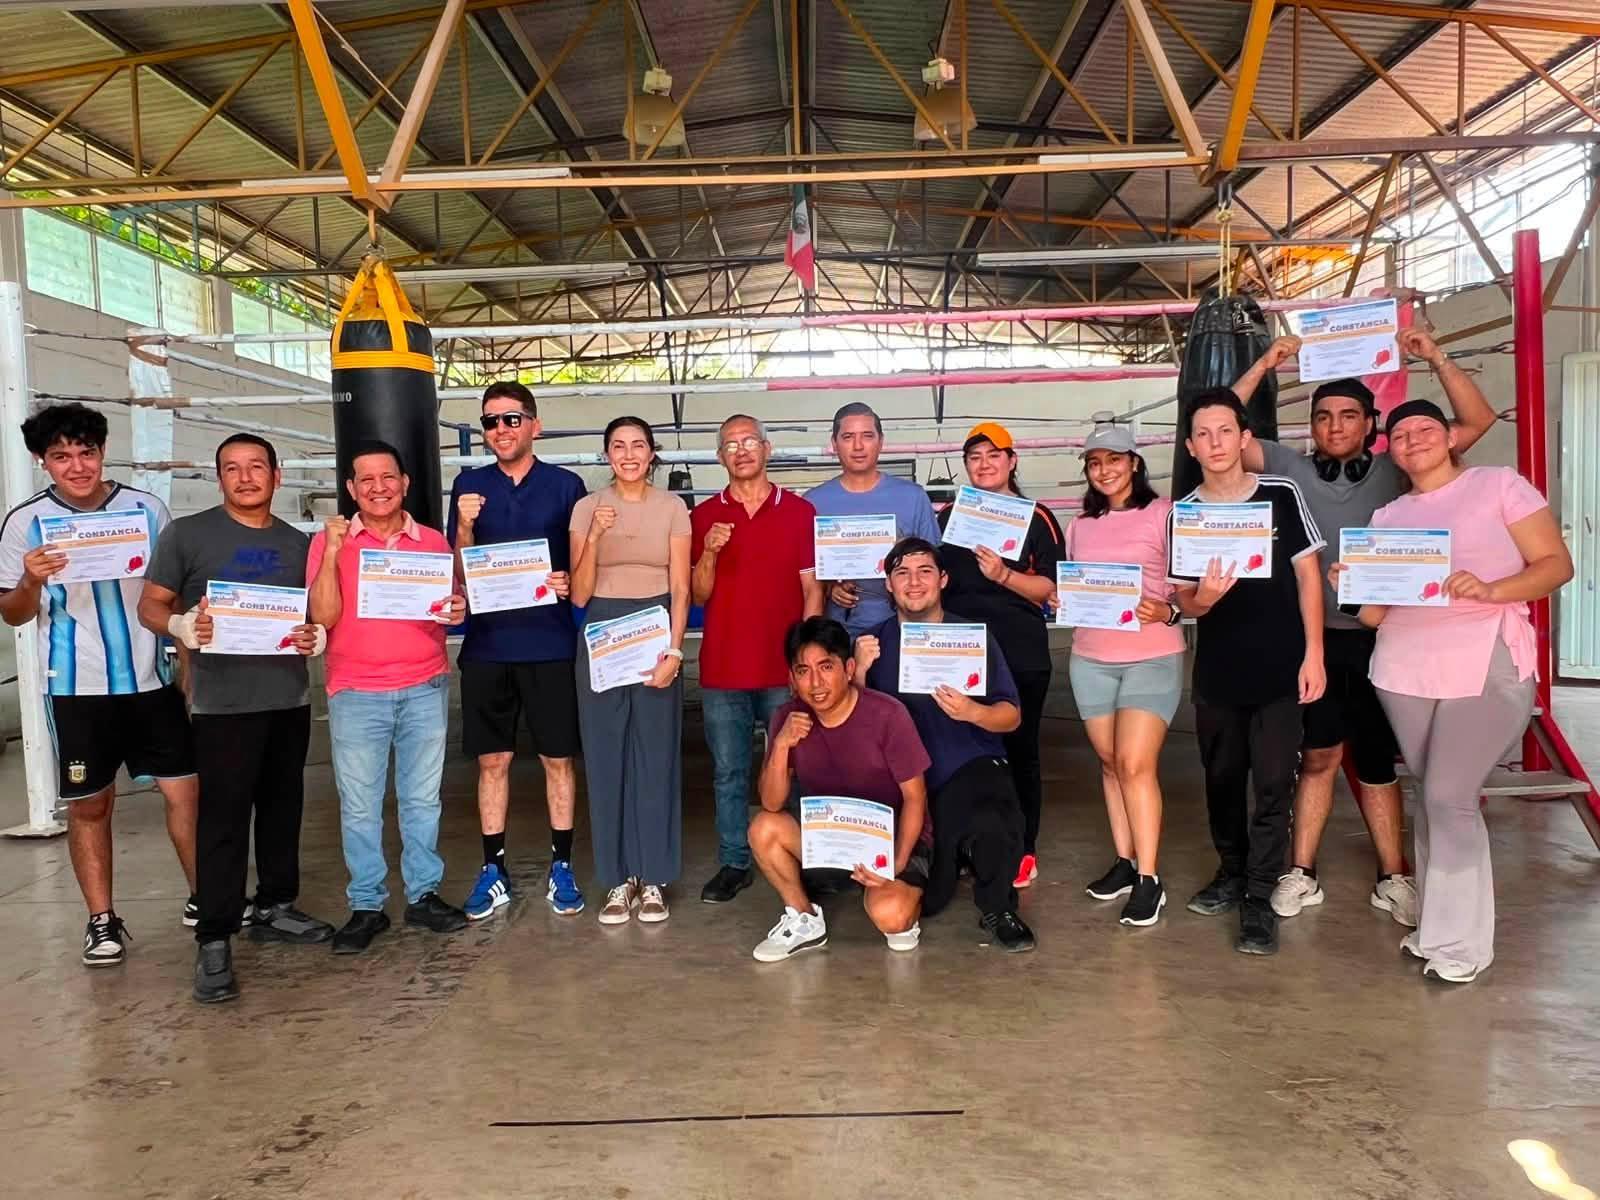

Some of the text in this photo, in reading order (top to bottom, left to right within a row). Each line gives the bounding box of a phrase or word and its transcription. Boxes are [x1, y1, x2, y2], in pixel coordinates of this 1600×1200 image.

[1330, 319, 1389, 332] CONSTANCIA
[1203, 521, 1264, 529] CONSTANCIA
[79, 528, 140, 539] CONSTANCIA
[840, 530, 889, 538] CONSTANCIA
[492, 557, 544, 568] CONSTANCIA
[391, 569, 446, 577] CONSTANCIA
[1084, 579, 1135, 587] CONSTANCIA
[240, 602, 299, 613] CONSTANCIA
[612, 624, 661, 643] CONSTANCIA
[930, 641, 980, 649] CONSTANCIA
[834, 815, 888, 831] CONSTANCIA
